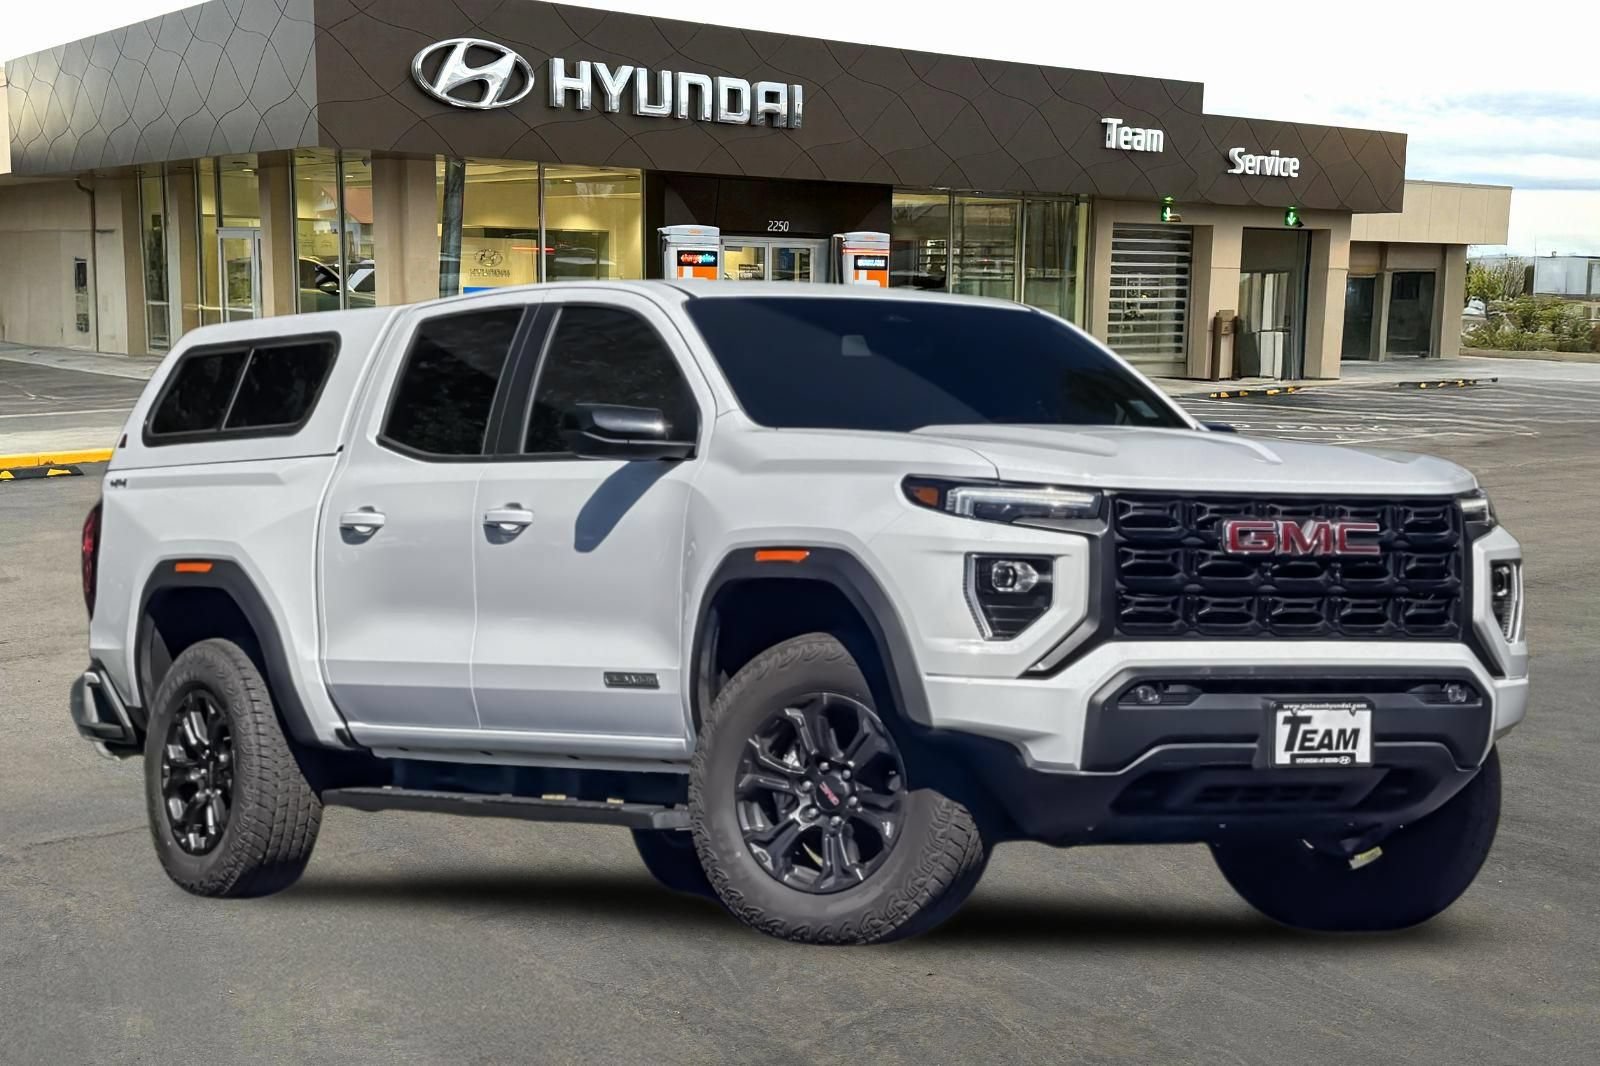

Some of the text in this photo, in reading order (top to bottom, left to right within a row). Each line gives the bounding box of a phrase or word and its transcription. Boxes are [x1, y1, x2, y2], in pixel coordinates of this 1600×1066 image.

[548, 57, 803, 129] HYUNDAI
[1101, 117, 1164, 152] Team
[1227, 147, 1300, 178] Service
[767, 220, 790, 232] 2250
[1222, 519, 1381, 555] GMC
[1282, 715, 1361, 752] TEAM
